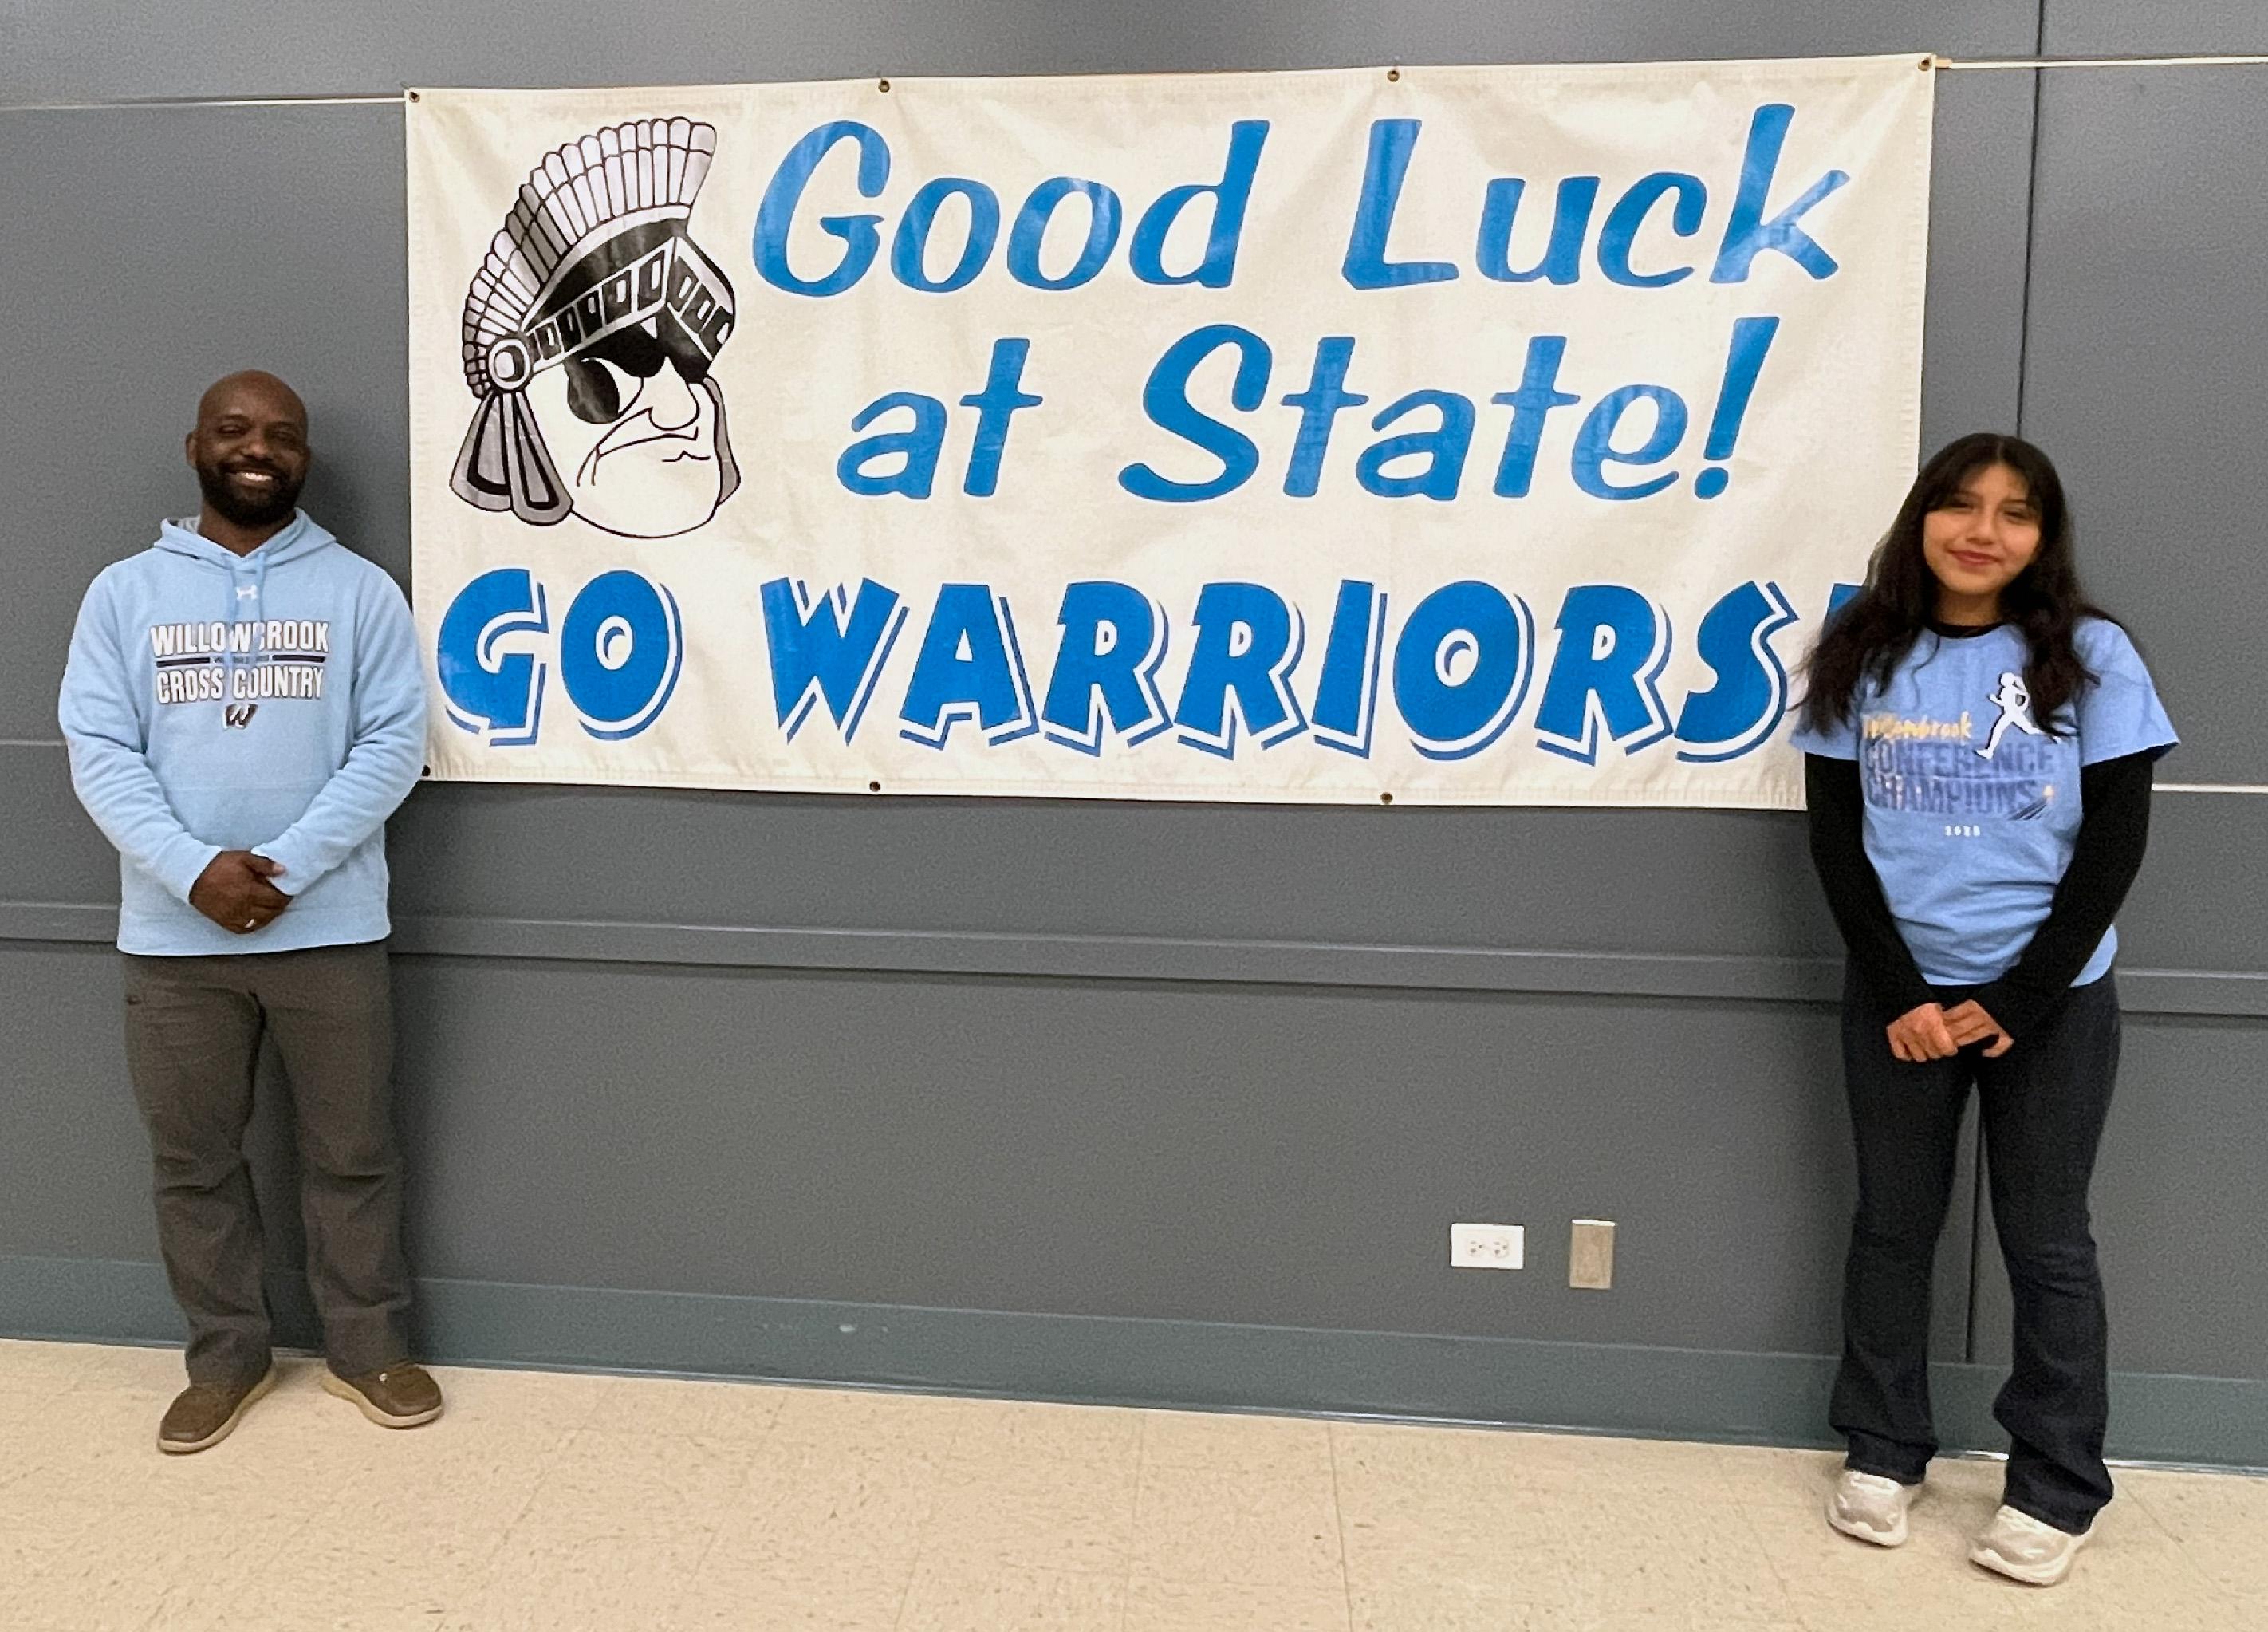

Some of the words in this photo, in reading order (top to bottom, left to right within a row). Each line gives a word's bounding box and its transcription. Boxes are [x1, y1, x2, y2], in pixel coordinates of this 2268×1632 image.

[752, 120, 1270, 298] Good
[1342, 104, 1849, 290] Luck
[836, 337, 1043, 499] at
[1119, 316, 1780, 503] State!
[156, 667, 225, 704] CROSS
[231, 664, 324, 700] COUNTRY
[436, 568, 684, 747] GO
[760, 577, 1866, 767] WARRIORS
